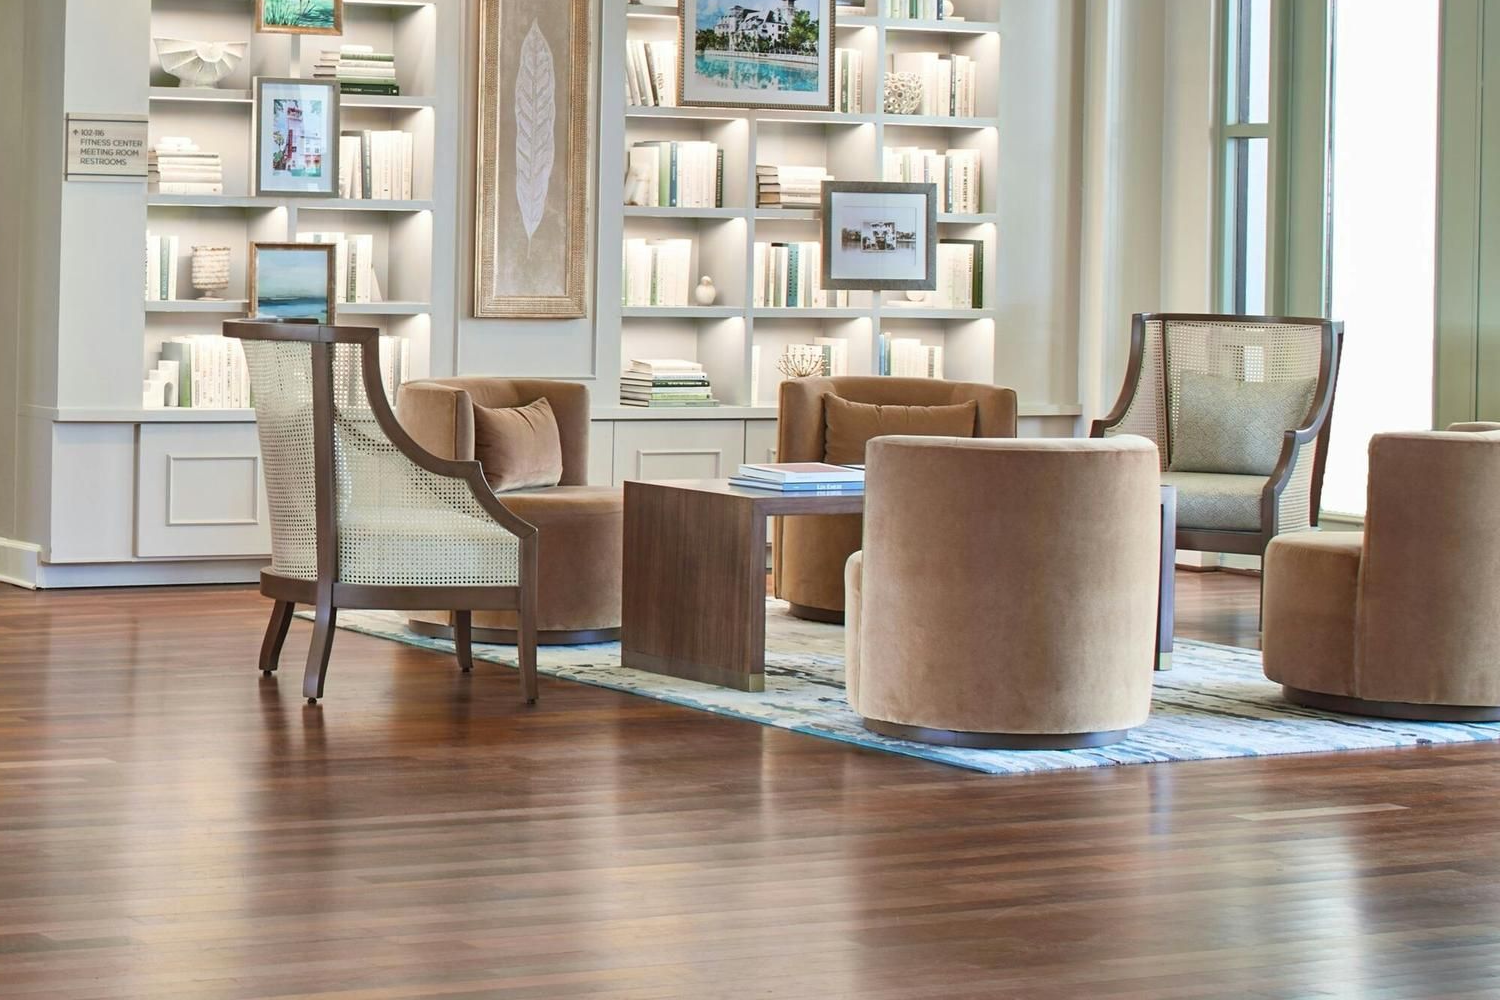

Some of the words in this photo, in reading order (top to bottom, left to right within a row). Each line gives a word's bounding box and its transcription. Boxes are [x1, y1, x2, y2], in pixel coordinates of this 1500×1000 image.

[81, 128, 105, 137] 102-116
[80, 138, 111, 147] FITNESS
[112, 140, 143, 148] CENTER
[80, 147, 114, 156] MEETING
[115, 149, 139, 157] ROOM
[80, 157, 128, 166] RESTROOMS
